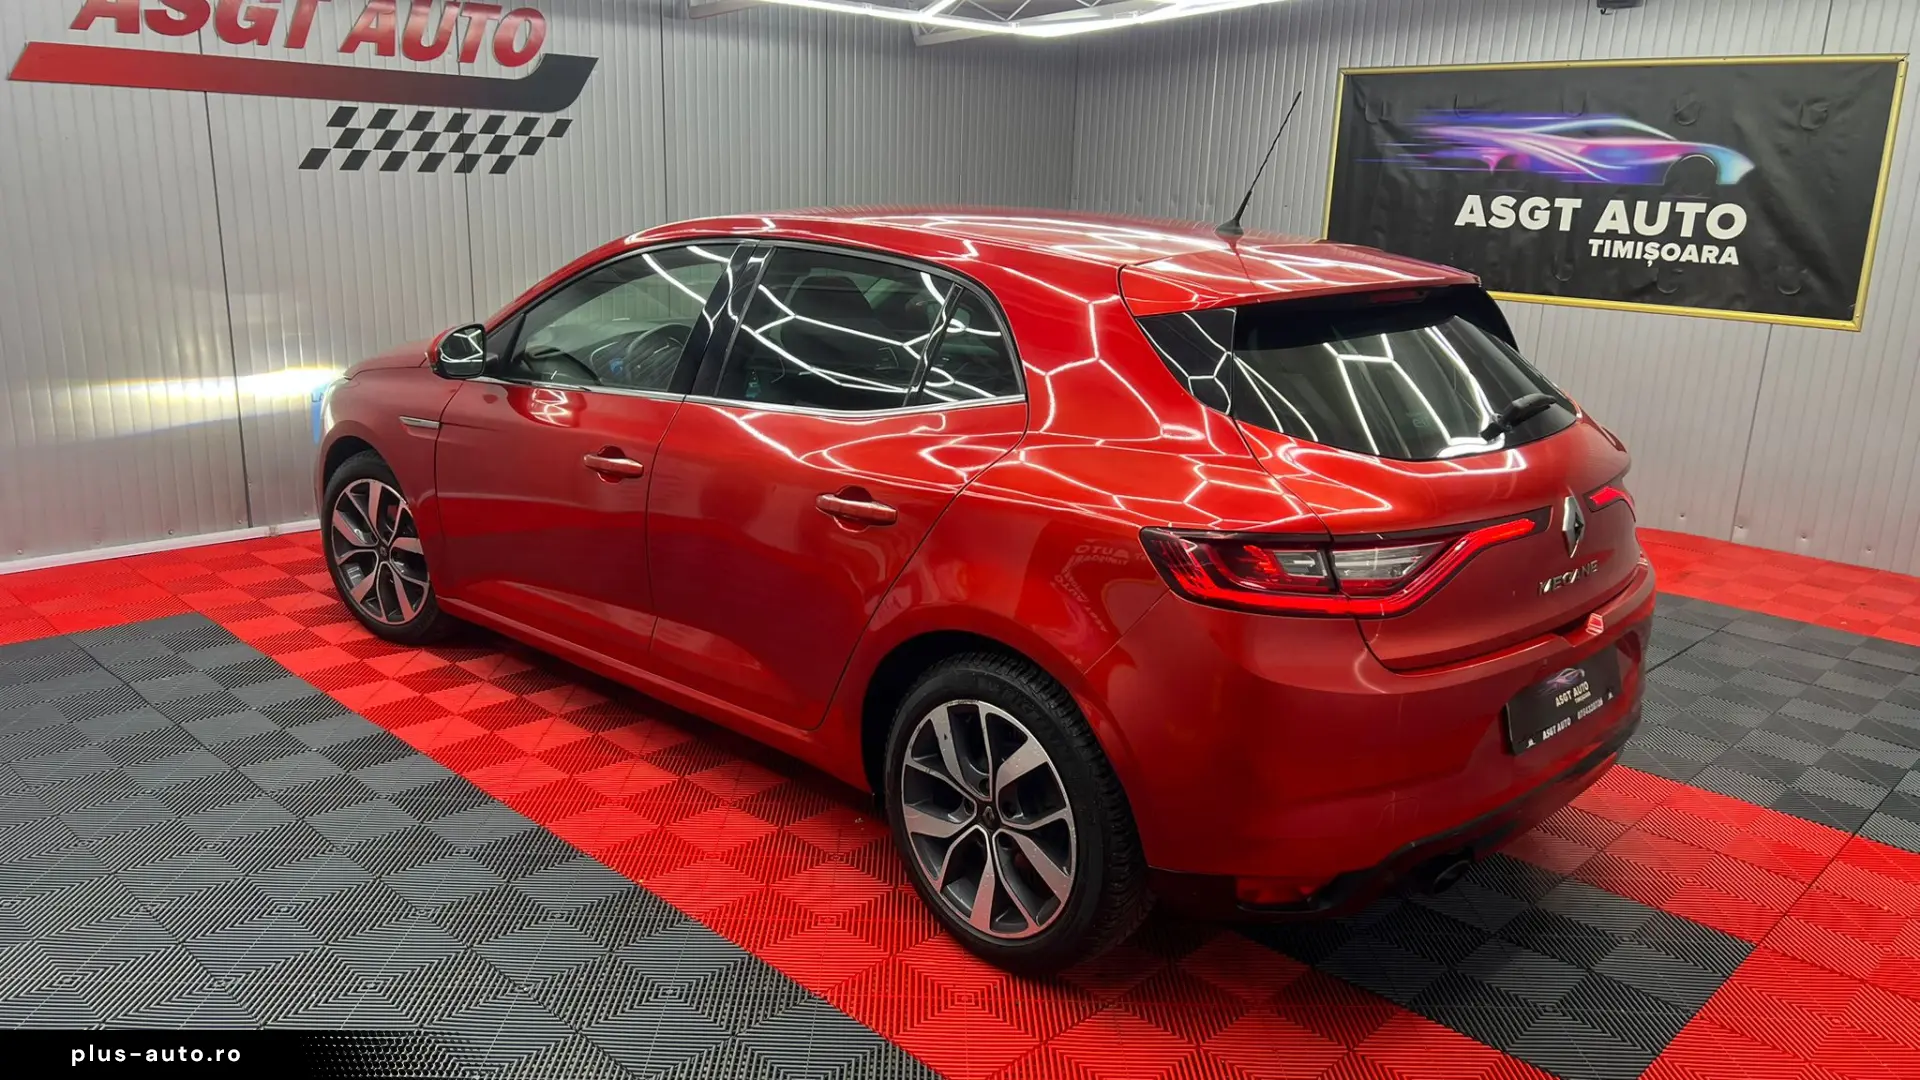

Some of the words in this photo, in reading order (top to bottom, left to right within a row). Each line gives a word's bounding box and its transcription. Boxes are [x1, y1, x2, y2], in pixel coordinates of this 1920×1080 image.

[70, 0, 328, 49] ASGT
[340, 0, 547, 67] AUTO
[1454, 194, 1583, 232] ASGT
[1593, 199, 1748, 240] AUTO
[1588, 238, 1740, 268] TIMIȘOARA
[1538, 559, 1599, 596] MEGANE
[1572, 681, 1589, 698] AUTO
